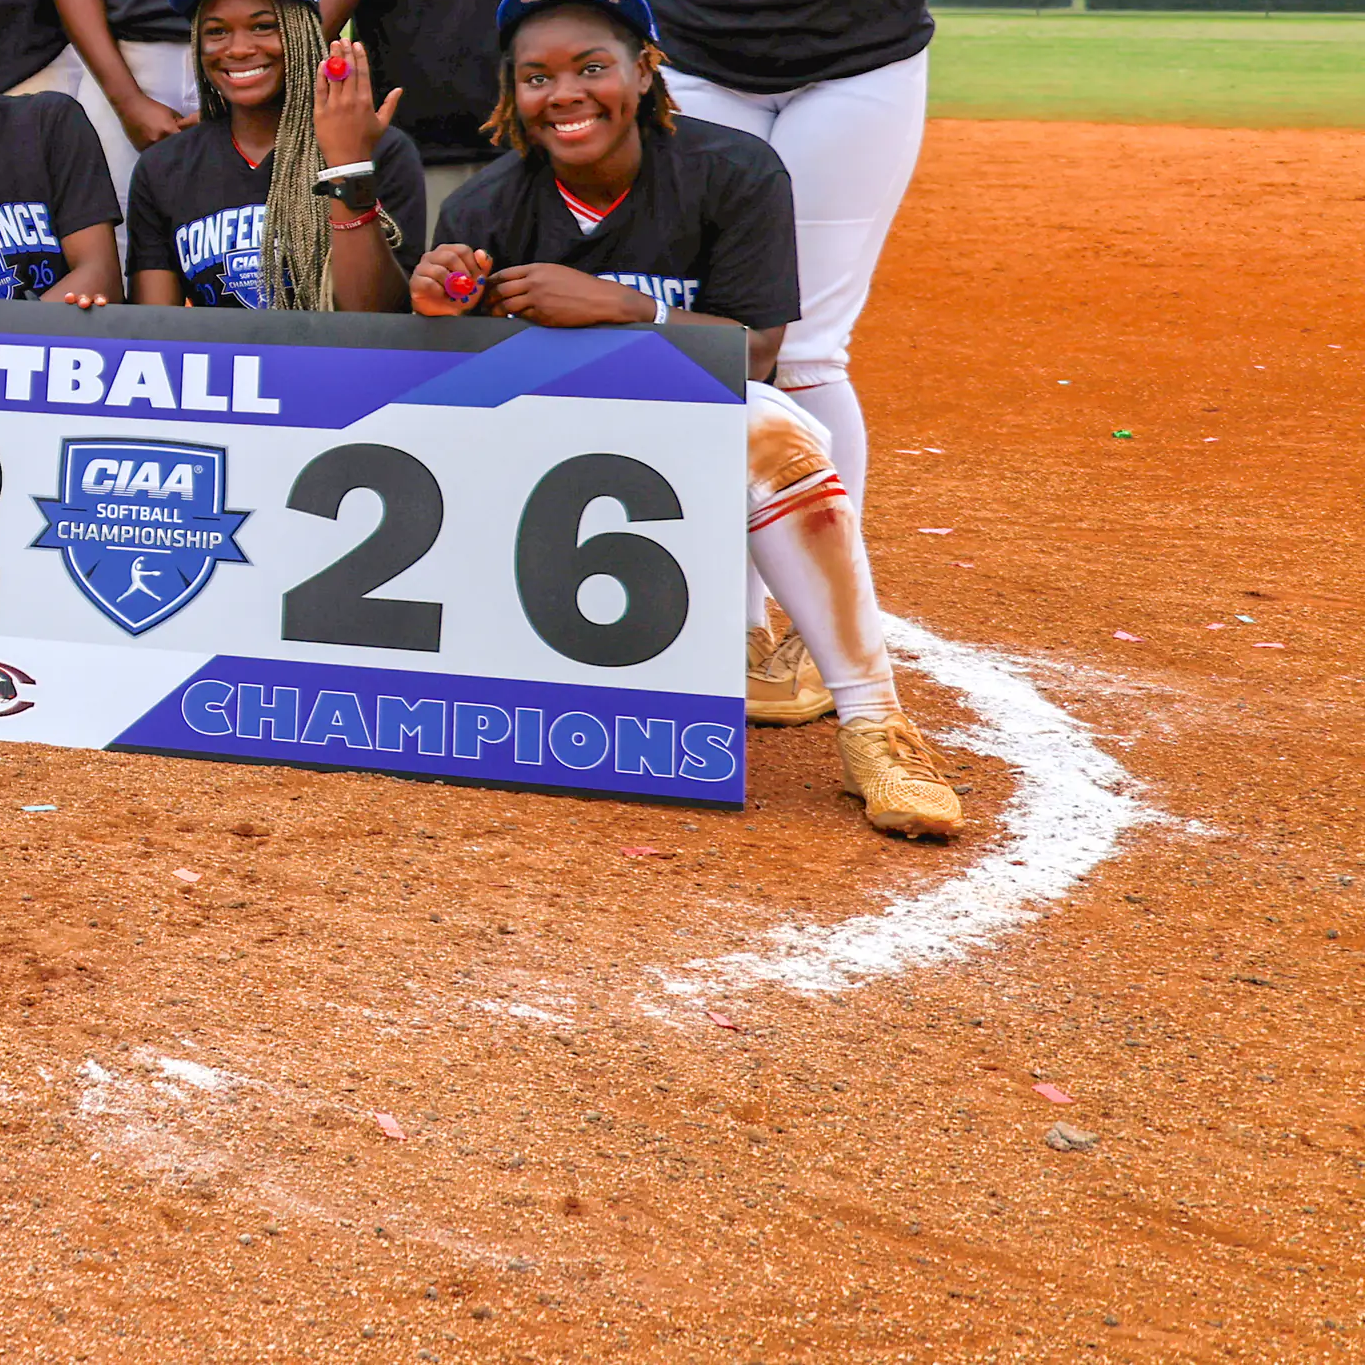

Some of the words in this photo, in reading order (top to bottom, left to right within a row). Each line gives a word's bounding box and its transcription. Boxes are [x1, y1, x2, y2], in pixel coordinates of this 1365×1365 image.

[29, 259, 55, 289] 26
[82, 458, 194, 501] CIAA
[96, 503, 183, 523] SOFTBALL
[57, 521, 223, 549] CHAMPIONSHIP
[181, 680, 736, 783] CHAMPIONS
